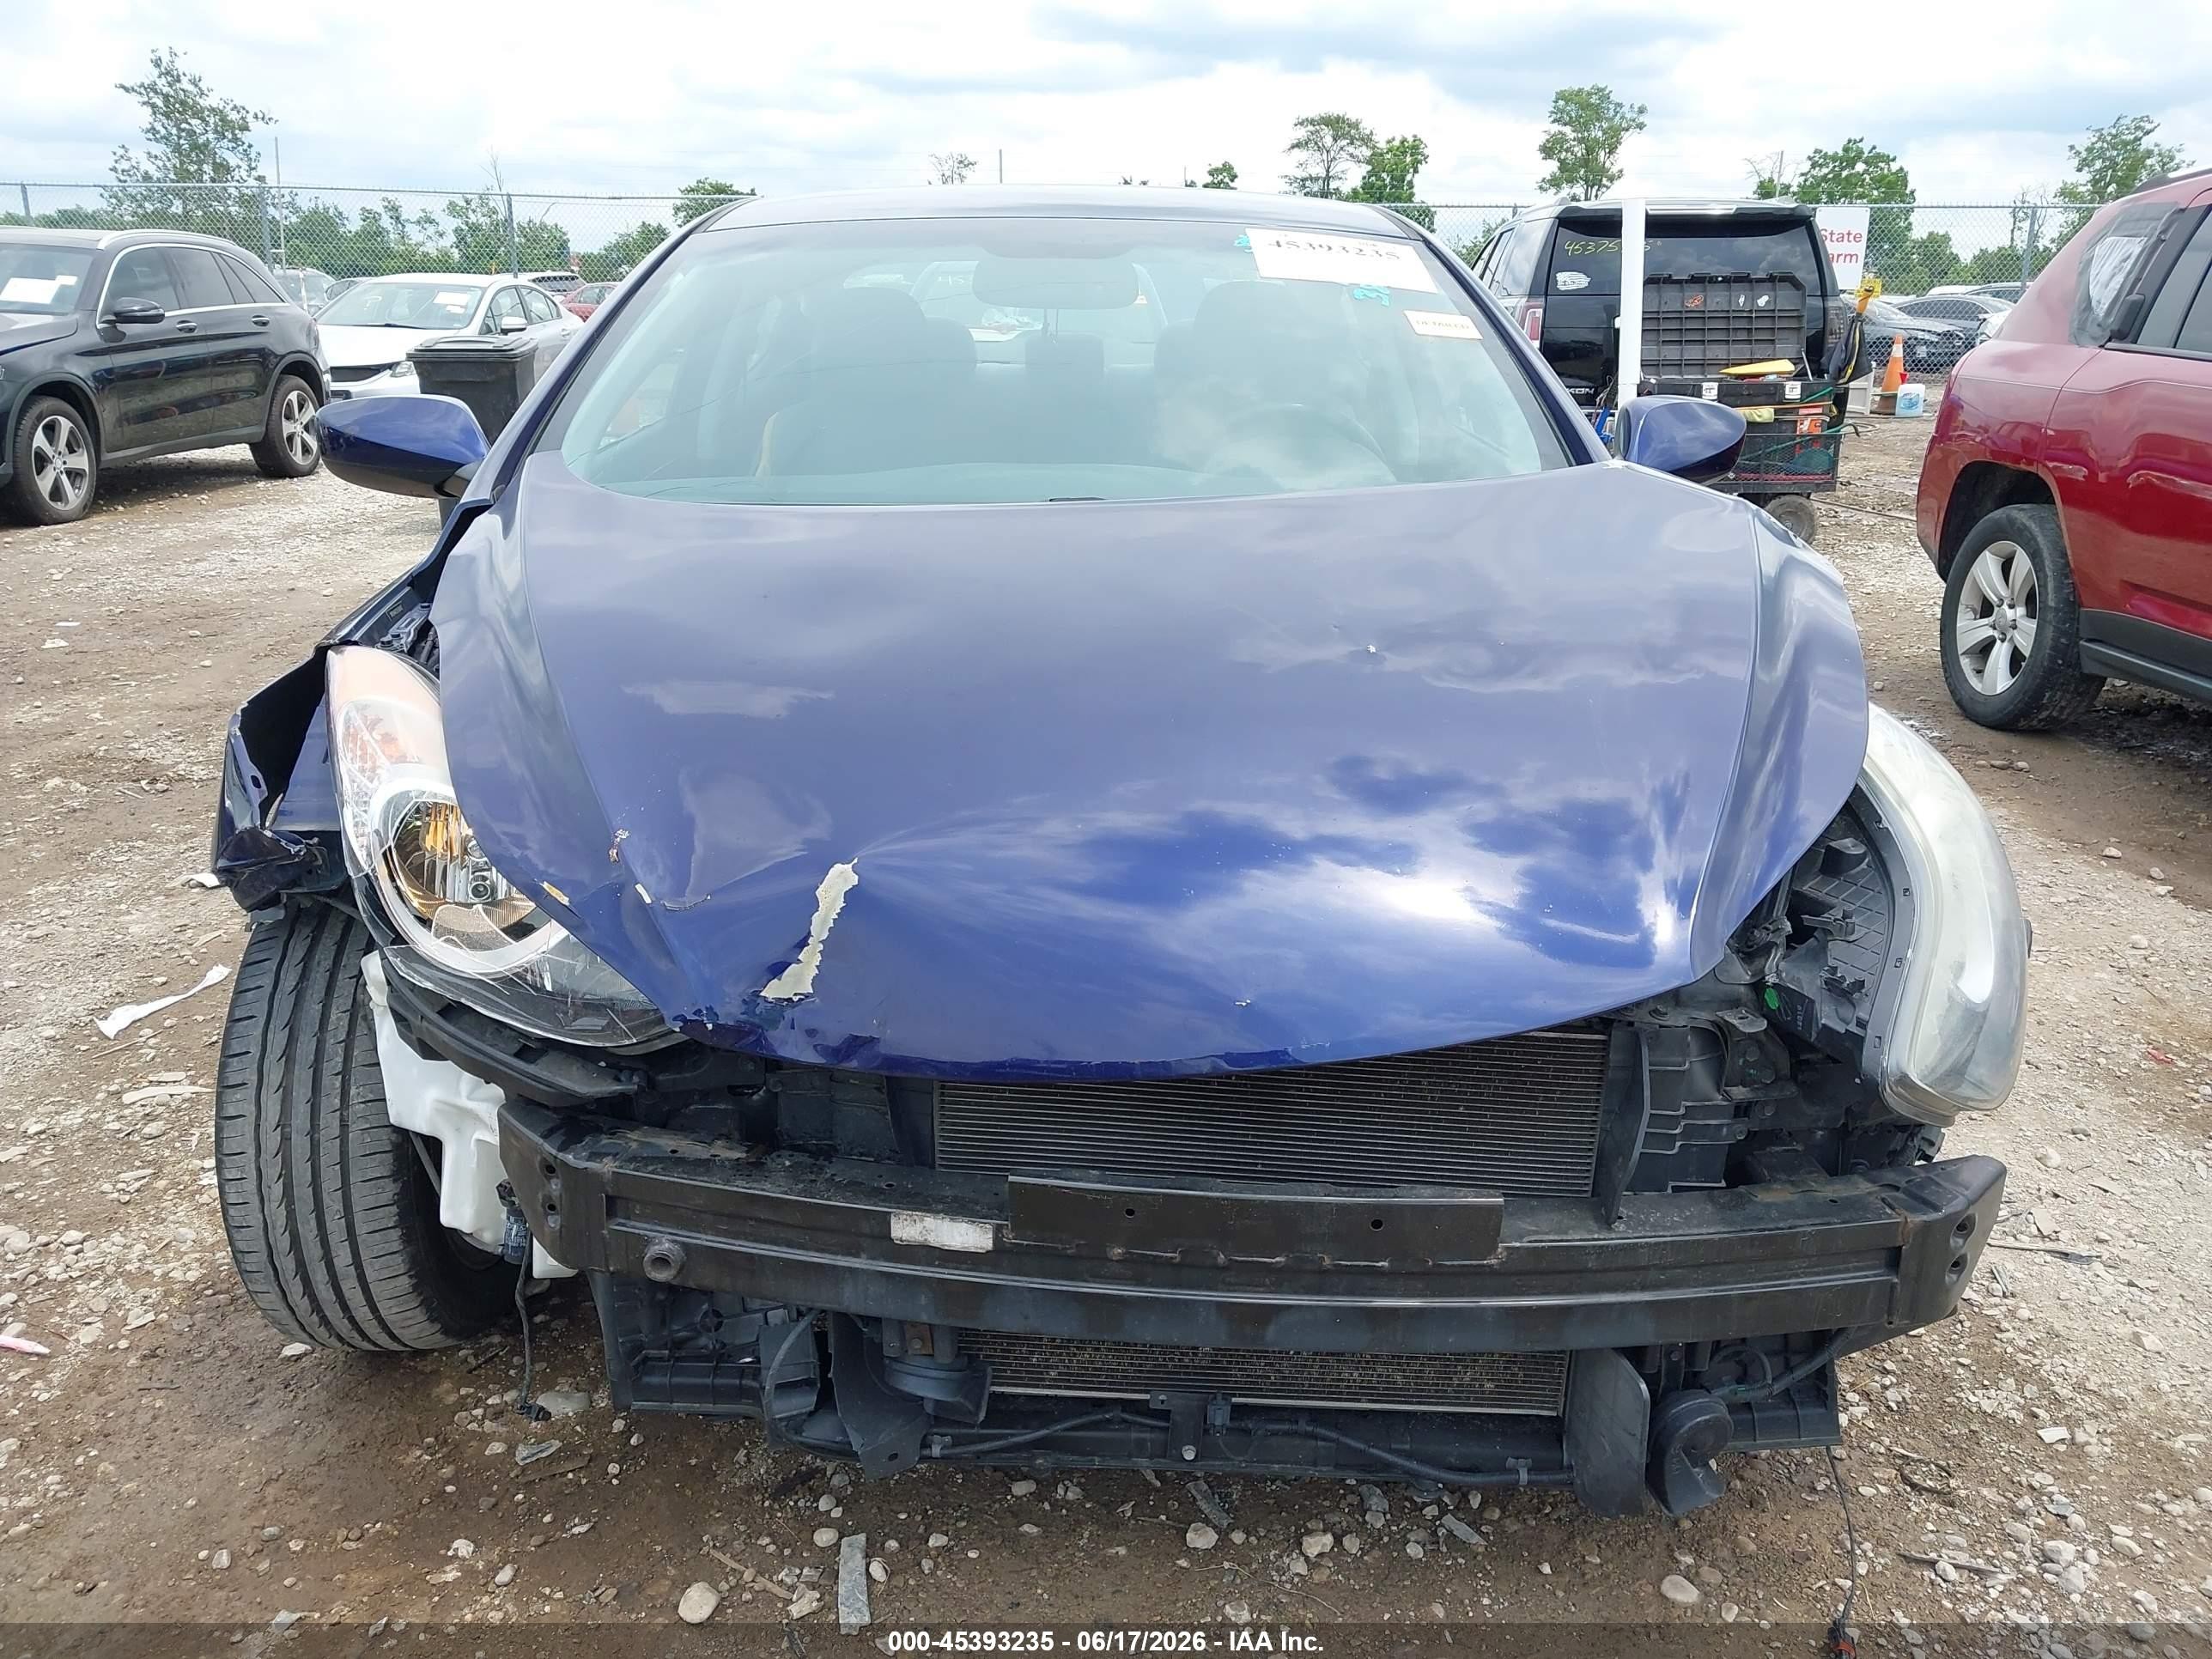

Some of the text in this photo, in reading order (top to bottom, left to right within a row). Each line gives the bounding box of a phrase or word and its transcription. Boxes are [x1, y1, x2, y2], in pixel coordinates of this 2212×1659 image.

[1820, 228, 1863, 243] State
[1565, 240, 1654, 256] 453755
[1828, 252, 1859, 264] arm
